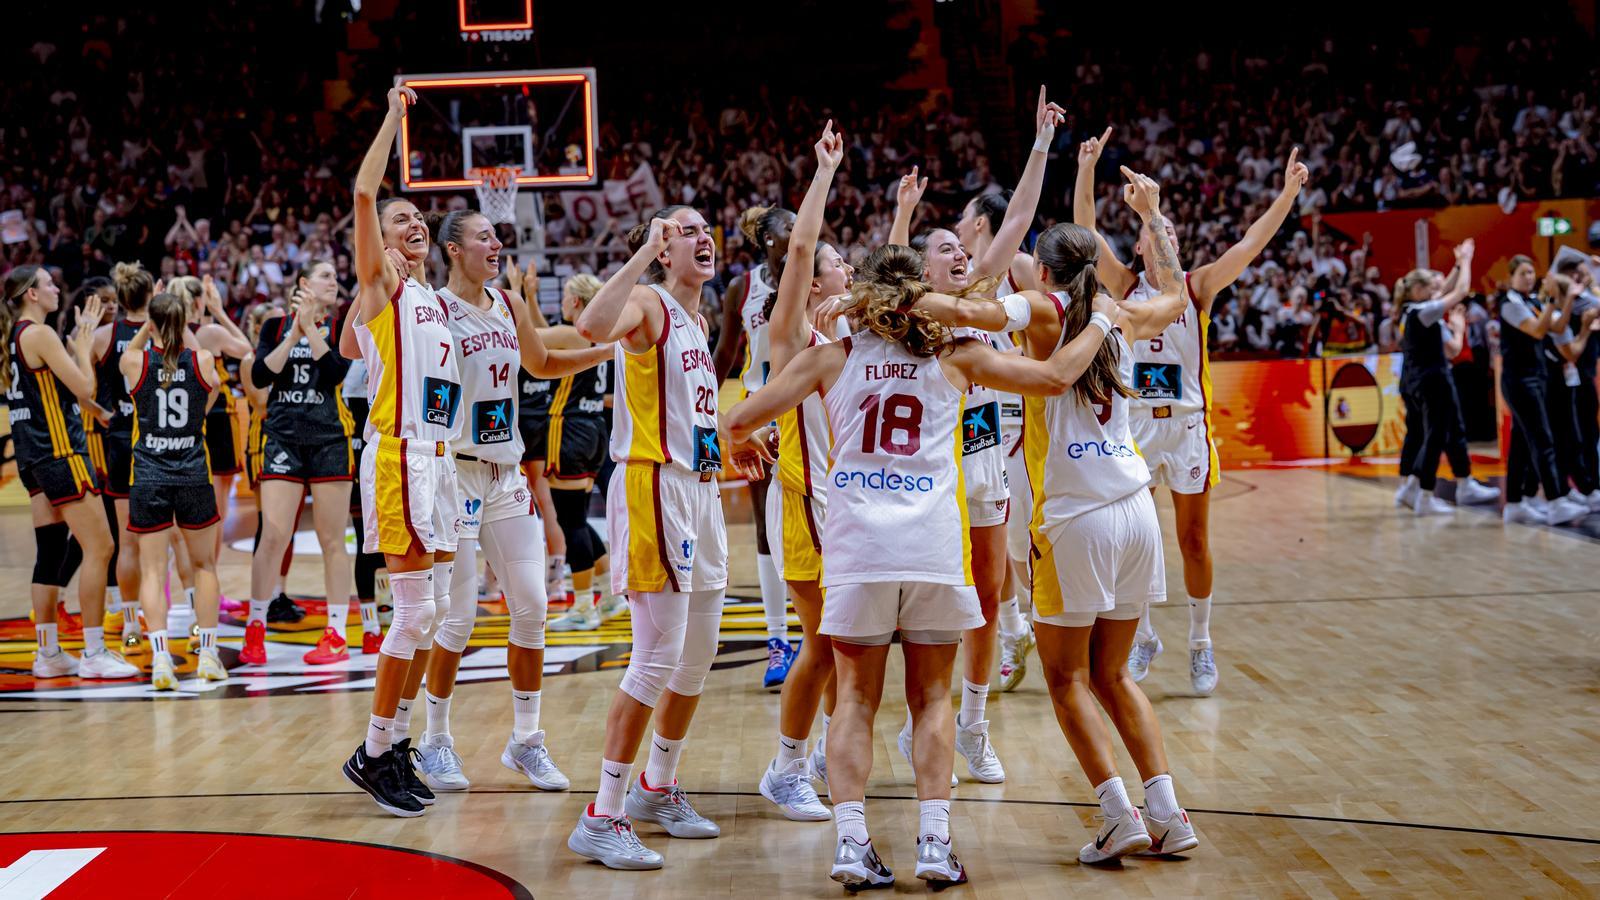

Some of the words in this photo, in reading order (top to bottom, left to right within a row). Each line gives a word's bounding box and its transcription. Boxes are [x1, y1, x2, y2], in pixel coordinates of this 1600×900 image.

[480, 29, 534, 42] TISSOT
[440, 342, 451, 368] 7
[293, 364, 311, 384] 15
[488, 363, 510, 388] 14
[865, 362, 918, 381] FLÓREZ
[278, 390, 303, 403] ING
[155, 388, 189, 428] 19
[859, 393, 924, 456] 18
[145, 433, 196, 452] tipwin
[834, 468, 934, 492] endesa
